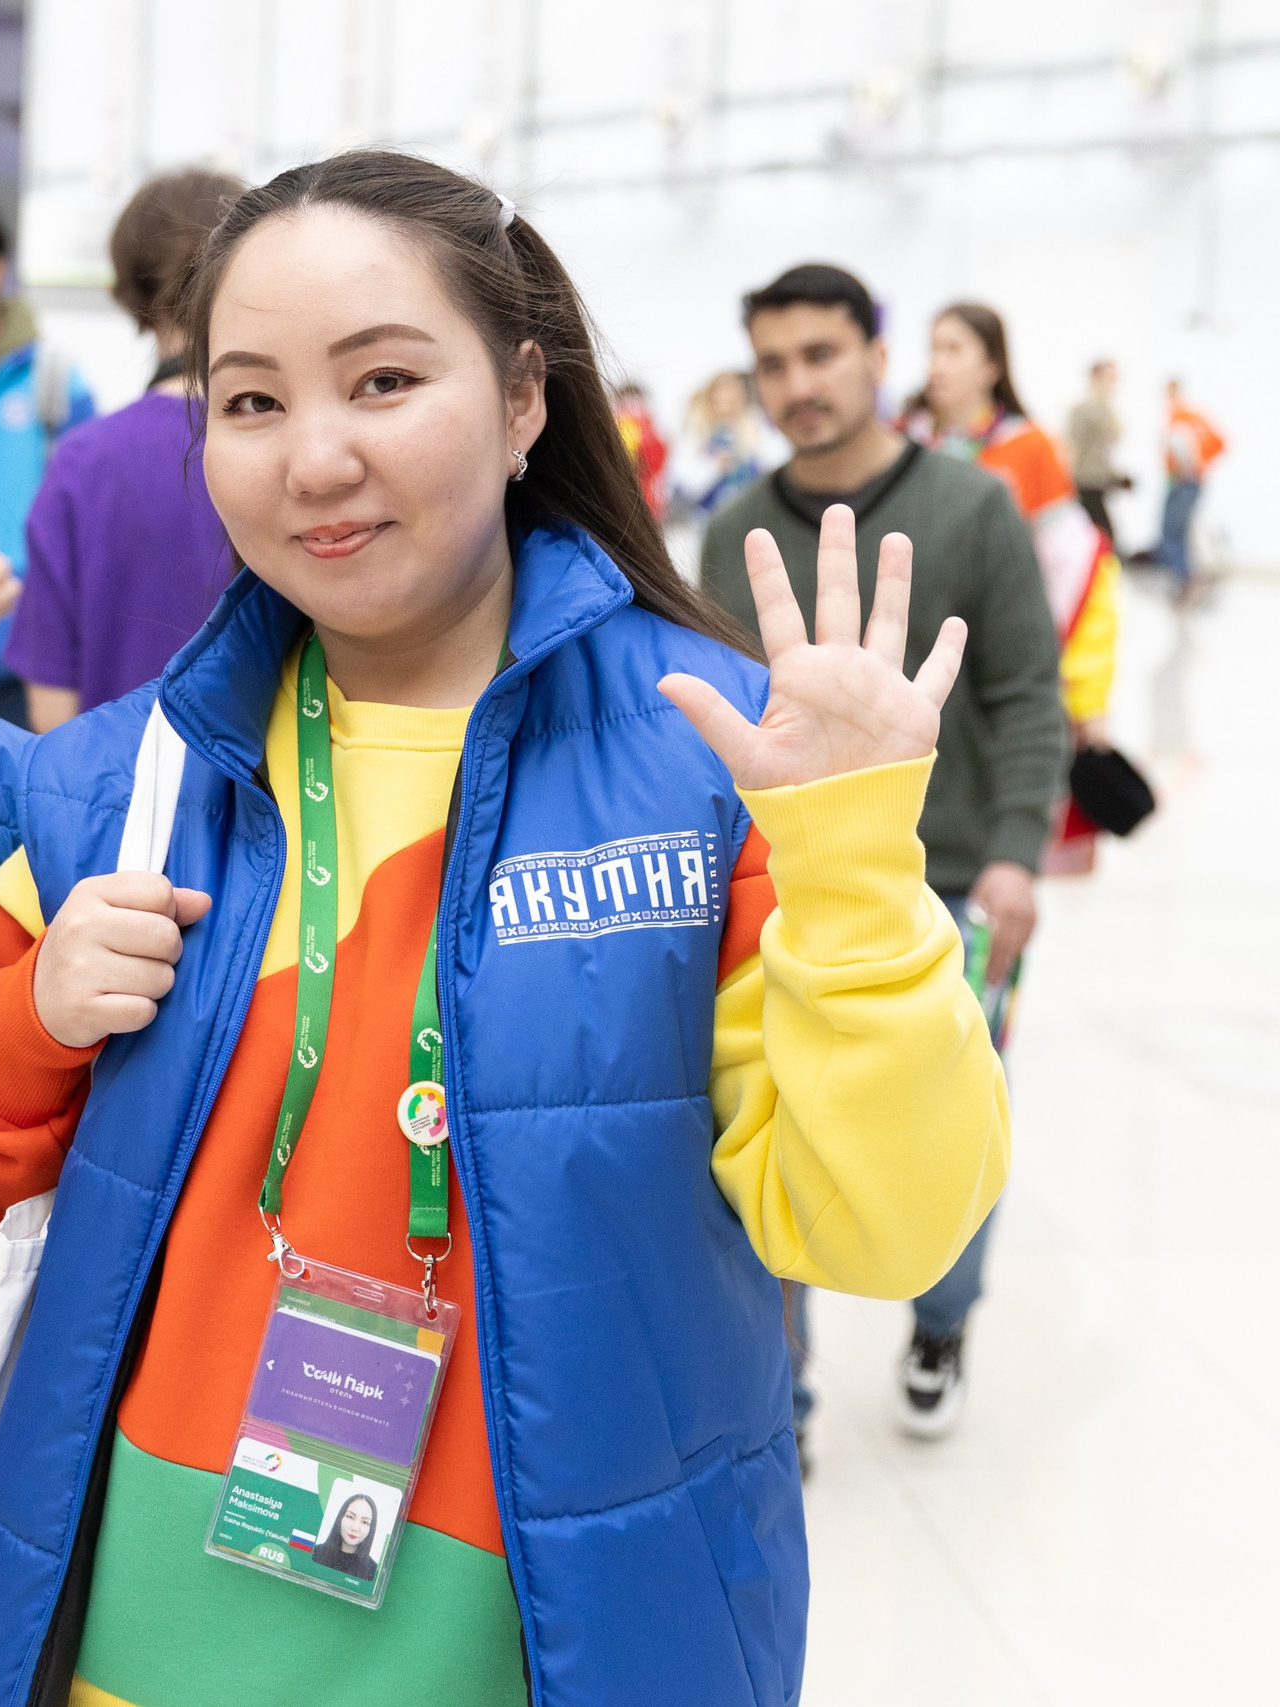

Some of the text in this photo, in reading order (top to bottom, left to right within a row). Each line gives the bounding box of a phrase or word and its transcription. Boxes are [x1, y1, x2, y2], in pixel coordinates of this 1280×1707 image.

[489, 850, 707, 926] ЯКУТИЯ
[303, 1361, 385, 1400] Сочи Парк
[228, 1495, 280, 1520] Maksimova
[232, 1485, 283, 1509] Anastasiya
[258, 1546, 285, 1563] RUS
